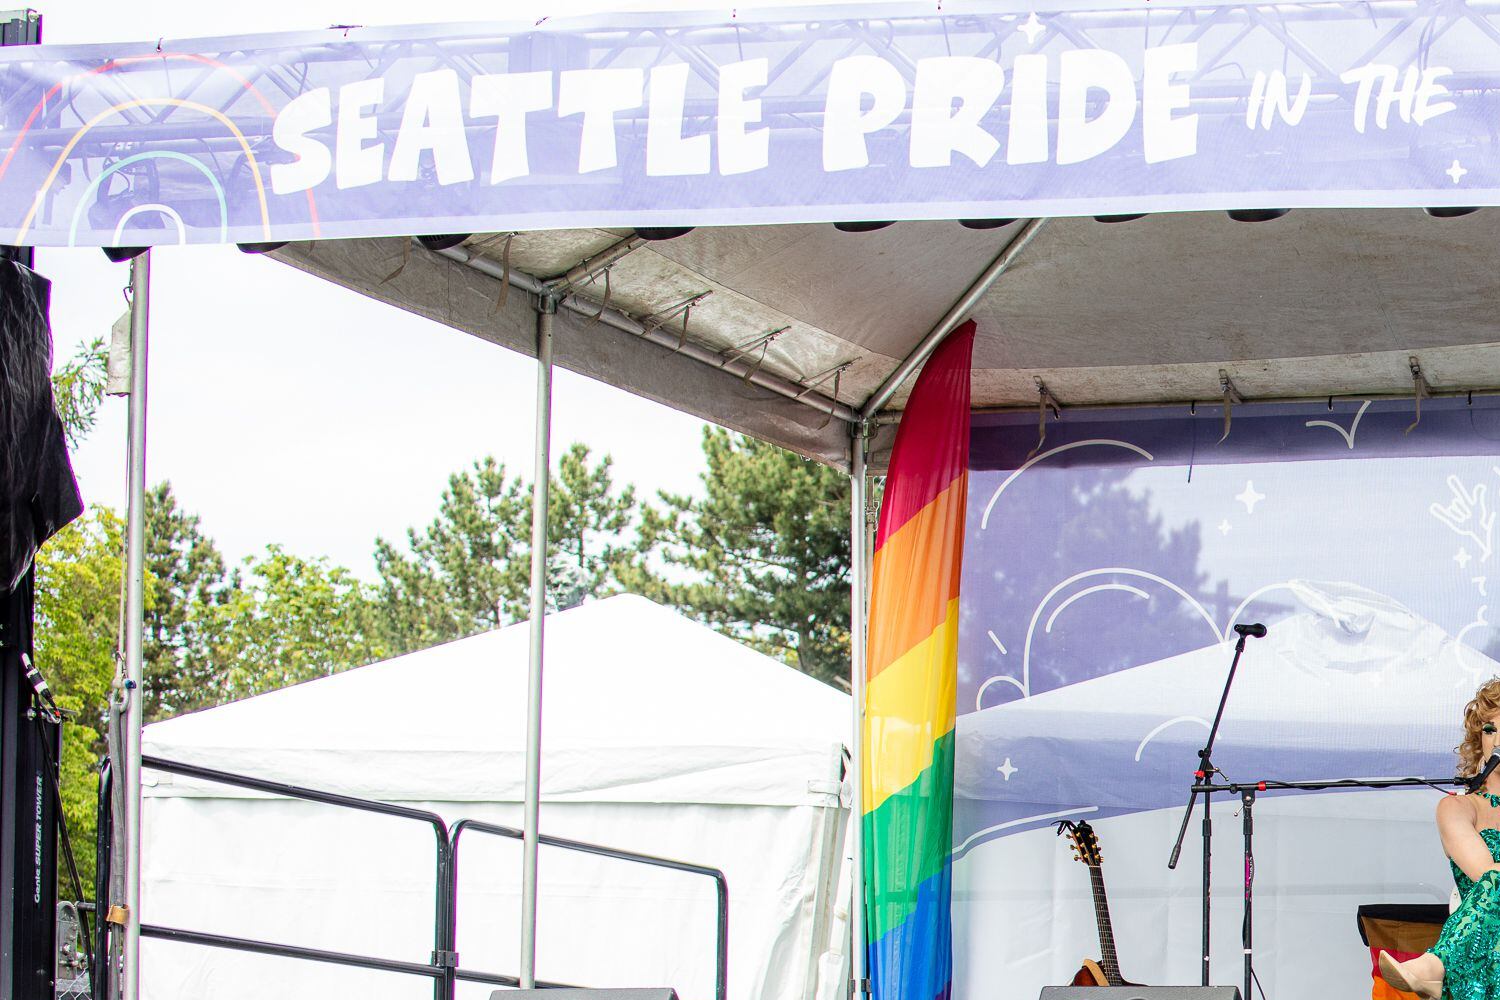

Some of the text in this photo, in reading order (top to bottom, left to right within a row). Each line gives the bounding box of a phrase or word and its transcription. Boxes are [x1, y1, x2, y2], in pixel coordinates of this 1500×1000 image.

[271, 58, 770, 196] SEATTLE
[823, 41, 1200, 173] PRIDE
[1245, 69, 1312, 131] IN
[1342, 63, 1457, 134] THE
[34, 776, 44, 904] Genie SUPER TOWER
